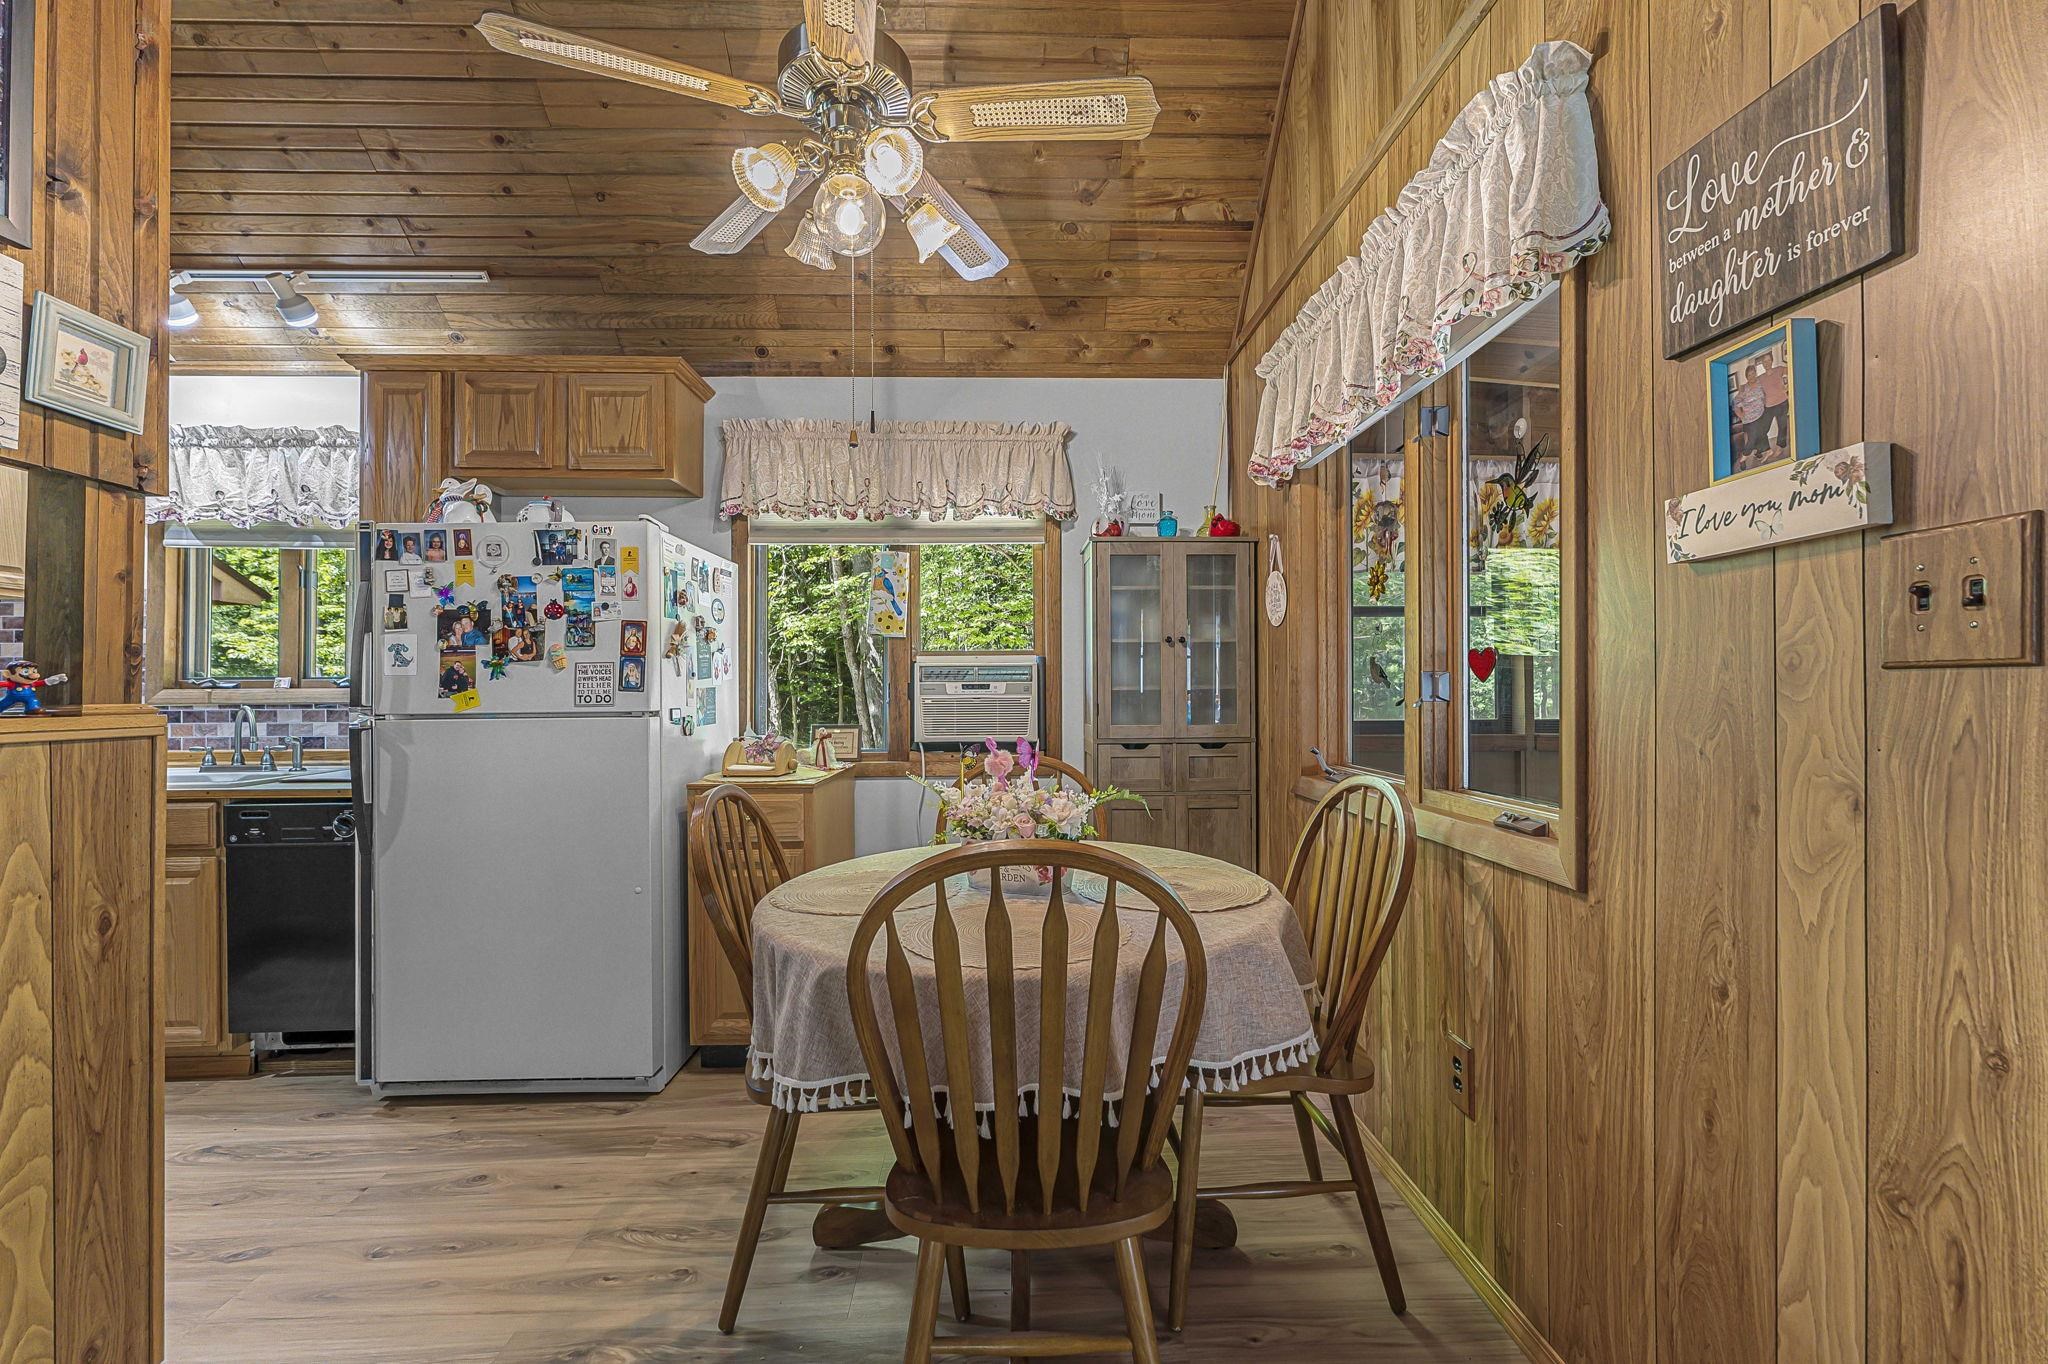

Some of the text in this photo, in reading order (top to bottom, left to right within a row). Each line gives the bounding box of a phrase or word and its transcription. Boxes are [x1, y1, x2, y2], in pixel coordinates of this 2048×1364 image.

[1669, 128, 1870, 273] between a mother &
[1670, 205, 1871, 327] daughter is forever
[1678, 483, 1844, 539] I love you mom
[592, 524, 614, 536] Gary
[577, 694, 612, 703] TO DO
[1001, 872, 1026, 882] RDEN
